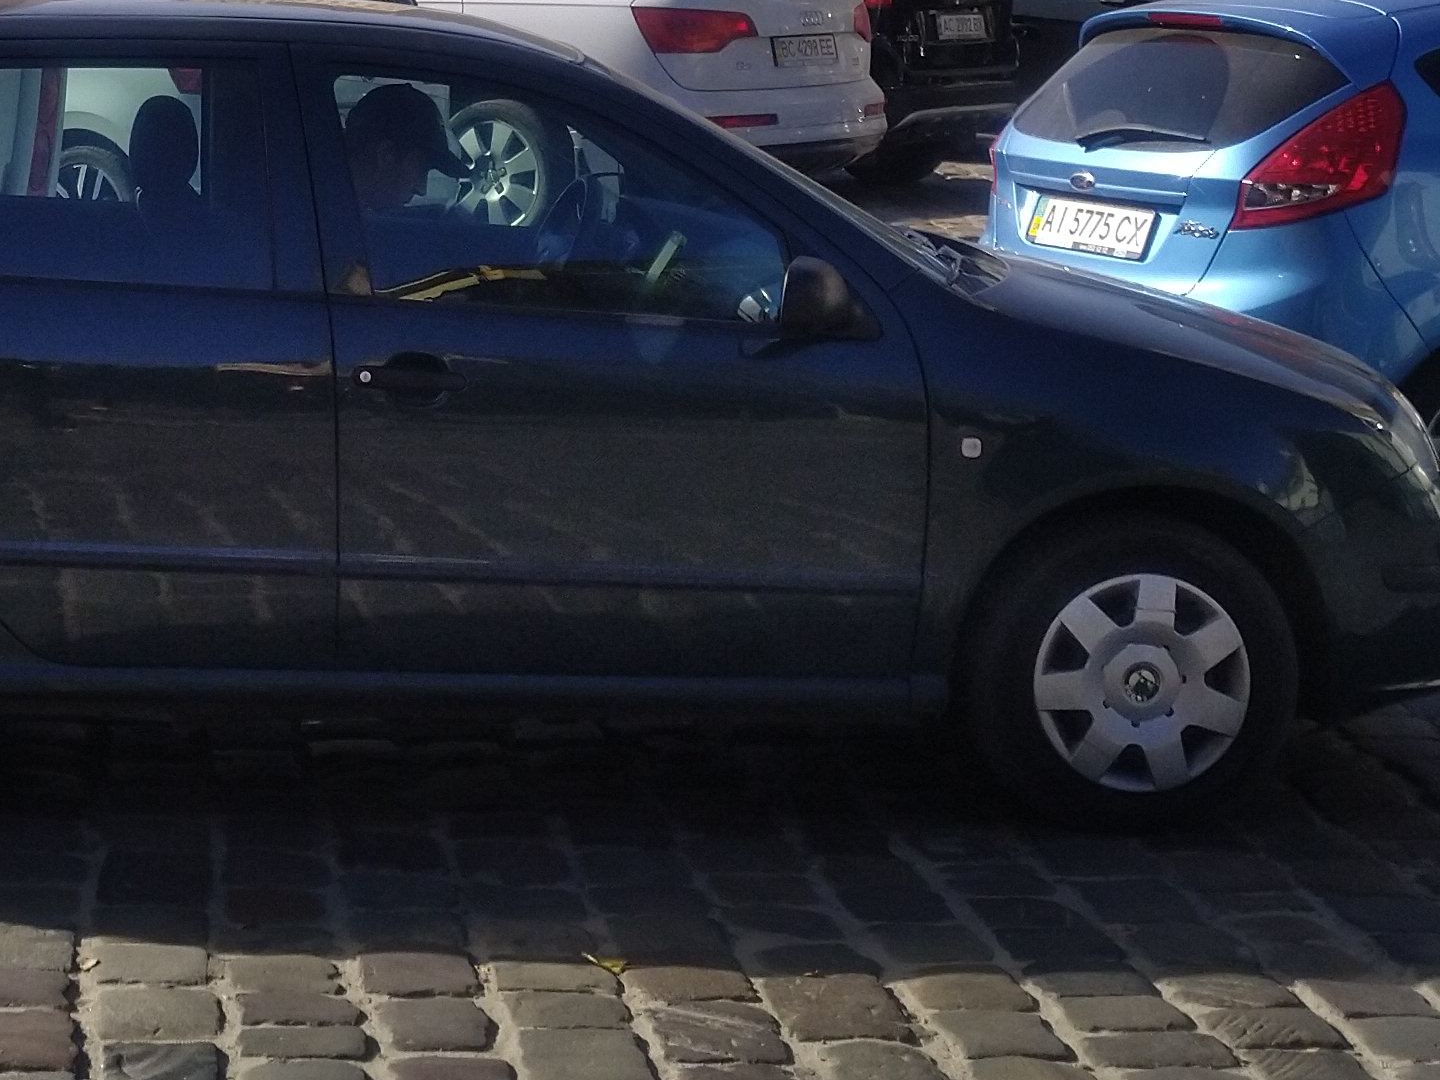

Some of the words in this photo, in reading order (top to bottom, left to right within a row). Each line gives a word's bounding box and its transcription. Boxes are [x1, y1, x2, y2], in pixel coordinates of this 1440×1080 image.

[781, 41, 796, 58] BC
[820, 39, 834, 55] EE
[1041, 205, 1068, 233] AI
[1069, 208, 1115, 240] 5775
[1115, 216, 1147, 247] CX
